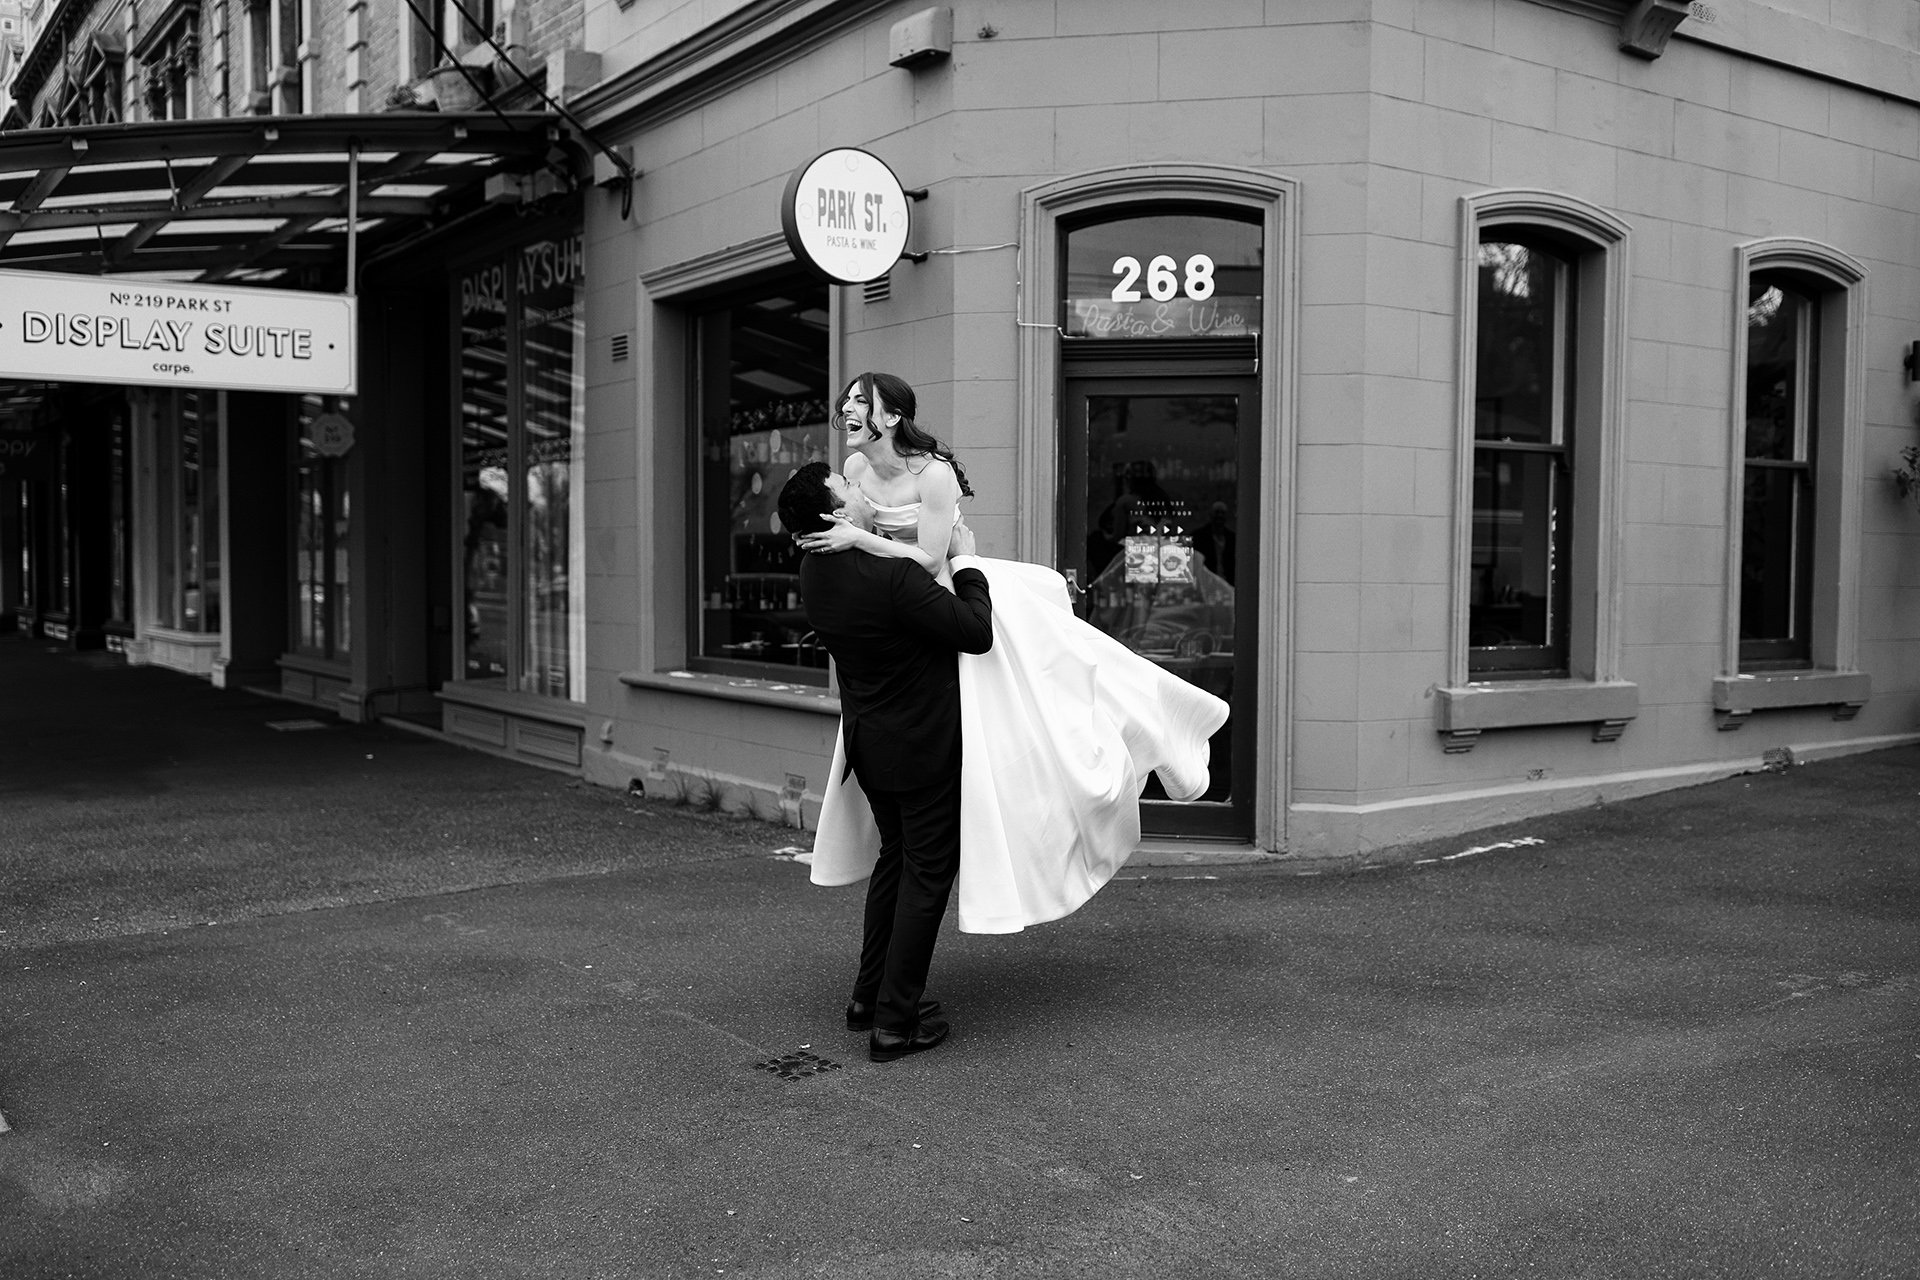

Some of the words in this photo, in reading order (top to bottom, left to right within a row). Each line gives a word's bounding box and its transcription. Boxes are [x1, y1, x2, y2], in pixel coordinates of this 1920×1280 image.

[817, 188, 856, 230] PARK
[864, 192, 886, 232] ST.
[826, 235, 850, 249] PASTA
[851, 237, 858, 249] &
[860, 238, 878, 251] WINE
[1111, 253, 1216, 303] 268
[133, 293, 163, 308] 219
[166, 296, 210, 312] PARK
[213, 300, 233, 313] ST
[1081, 302, 1150, 336] Pasta
[1150, 302, 1176, 334] &
[1186, 301, 1246, 334] Wine
[22, 310, 193, 353] DISPLAY
[204, 321, 313, 361] SUITE
